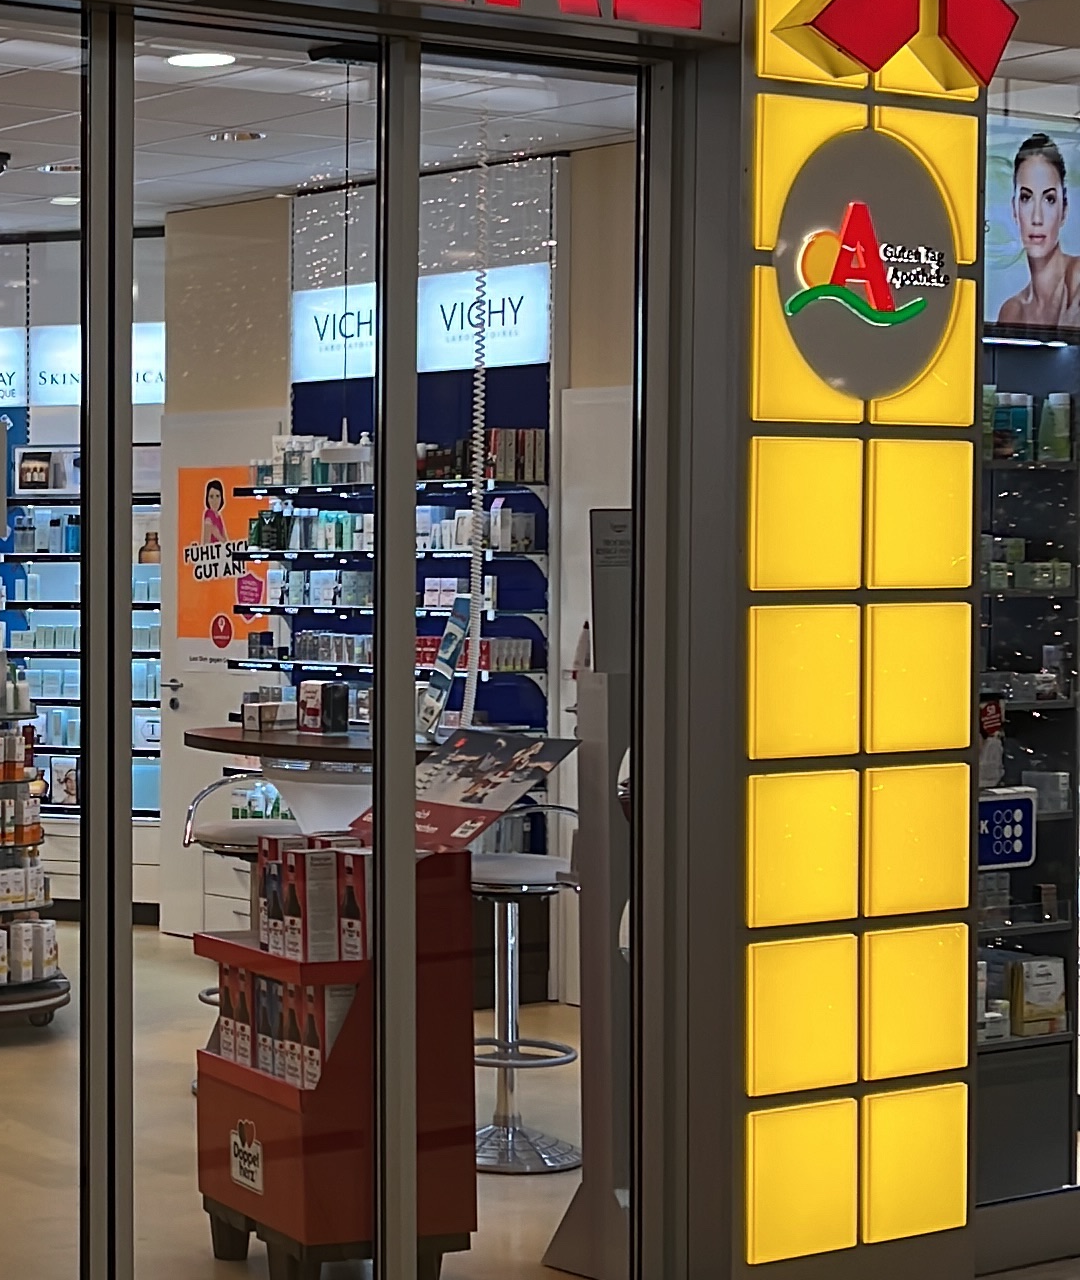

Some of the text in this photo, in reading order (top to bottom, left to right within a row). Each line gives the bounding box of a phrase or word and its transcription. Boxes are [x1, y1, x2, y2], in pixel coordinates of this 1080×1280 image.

[878, 243, 945, 268] Guten Tag
[886, 266, 950, 289] Apotheke
[313, 309, 373, 341] VICH
[439, 295, 524, 332] VICHY
[184, 542, 222, 563] FÜHLT
[194, 560, 246, 580] GUT AN!
[233, 1141, 260, 1169] Doppel
[239, 1160, 256, 1183] herz
